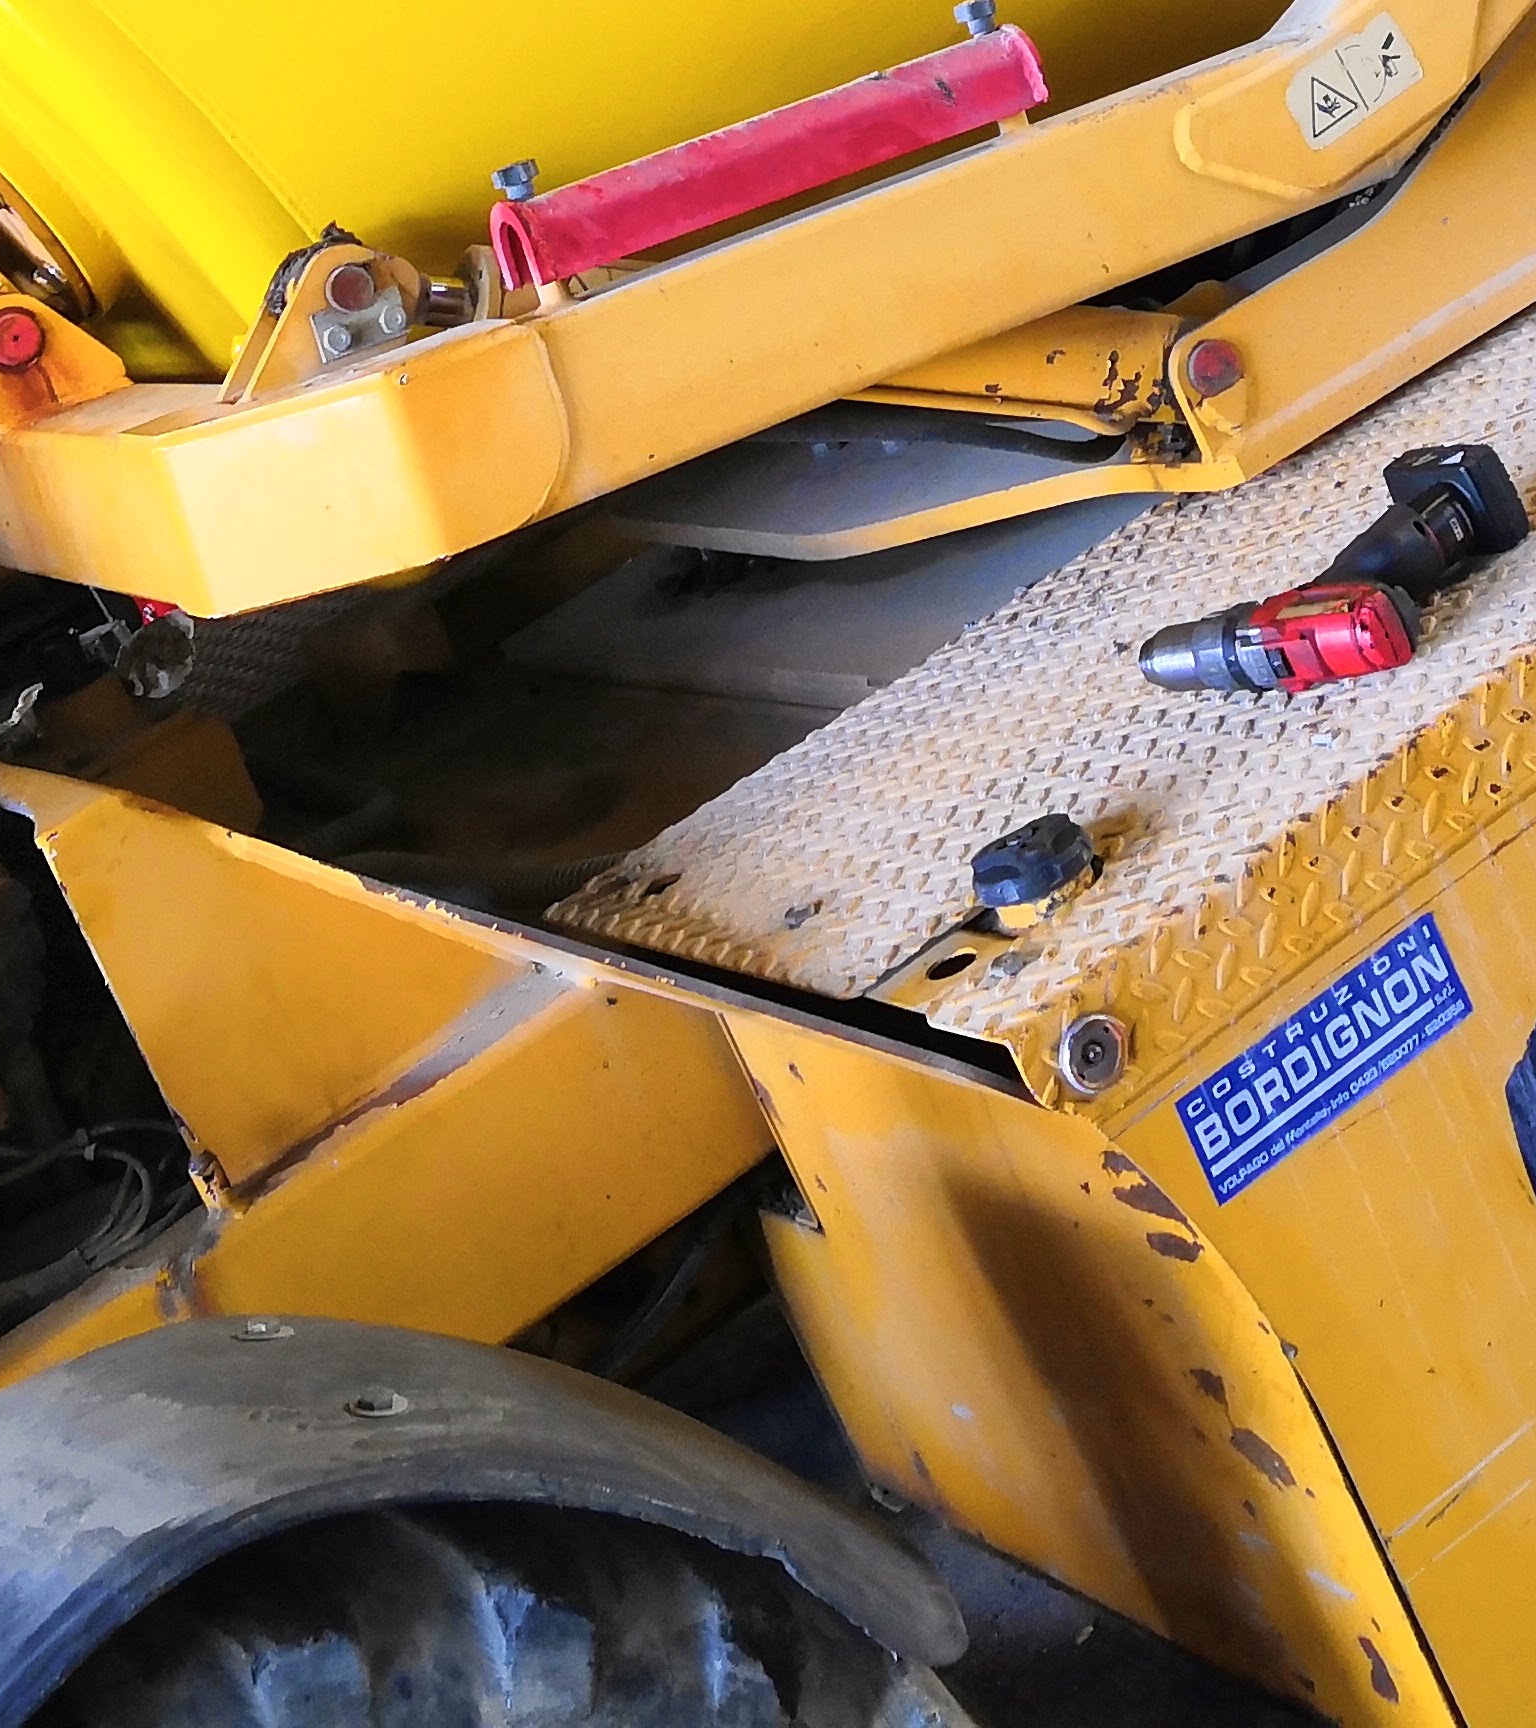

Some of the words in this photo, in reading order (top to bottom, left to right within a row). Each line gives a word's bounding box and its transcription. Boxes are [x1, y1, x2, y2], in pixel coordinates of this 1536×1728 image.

[1186, 925, 1432, 1119] COSTRUZIONI
[1194, 943, 1450, 1161] BORDIGNON
[1218, 1150, 1270, 1195] VOLPAGO
